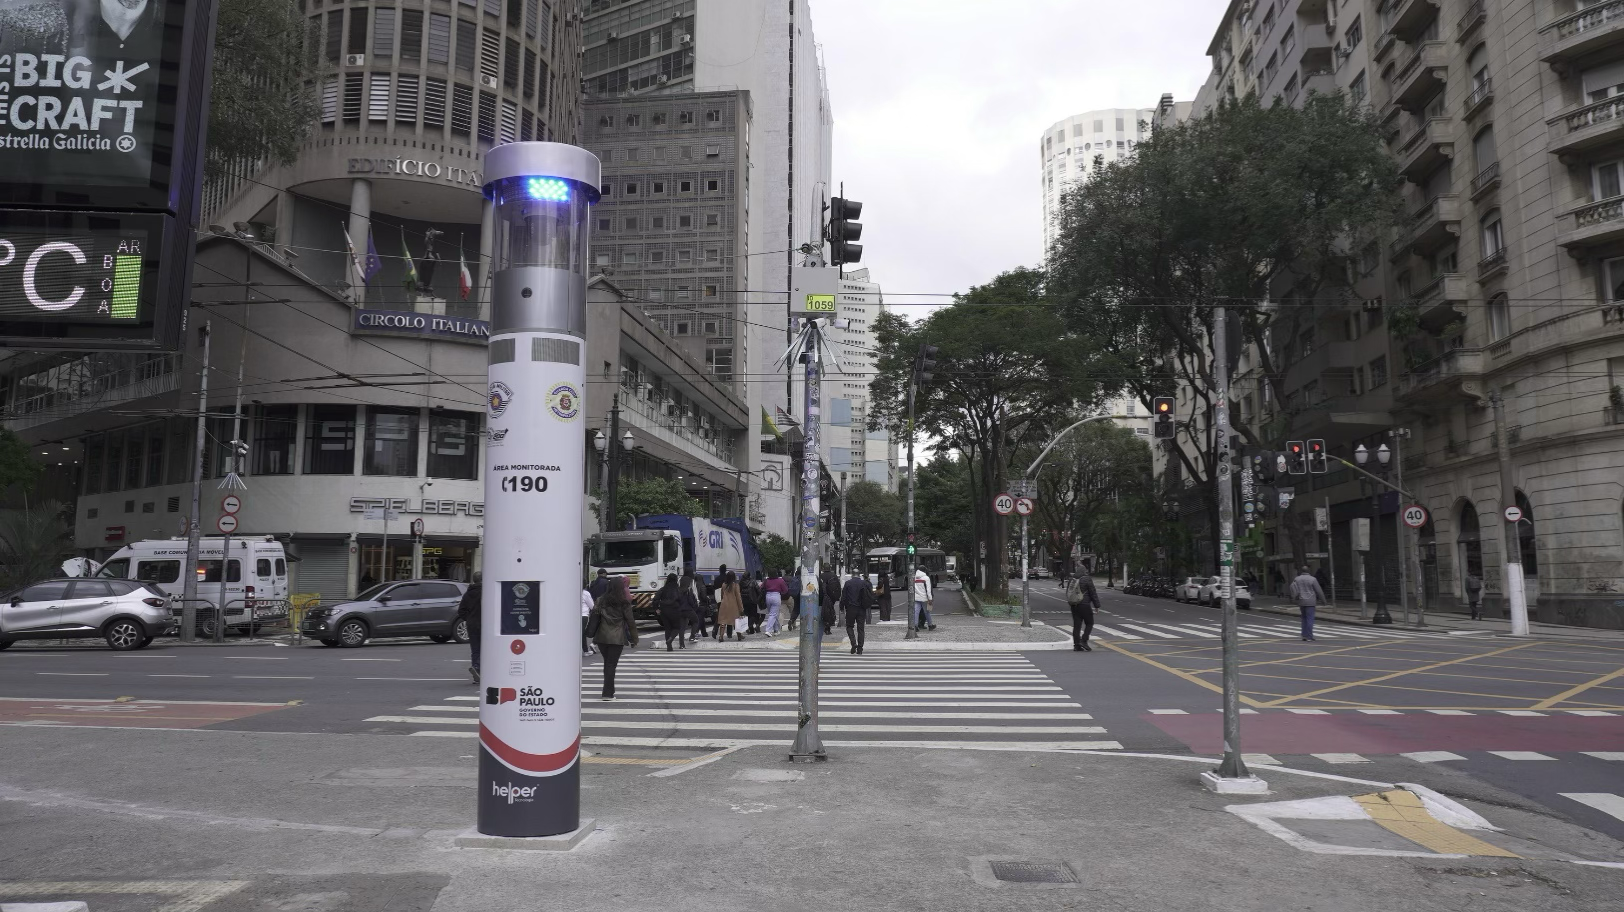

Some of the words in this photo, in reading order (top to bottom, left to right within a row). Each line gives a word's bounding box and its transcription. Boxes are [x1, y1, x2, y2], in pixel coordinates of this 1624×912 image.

[14, 53, 92, 89] BIG
[10, 95, 143, 133] CRAFT
[53, 133, 111, 151] Galicia
[347, 155, 441, 178] EDIFÍCIO
[117, 240, 141, 254] AR
[808, 300, 833, 310] 1059
[359, 313, 426, 329] CIRCOLO
[508, 475, 548, 492] 190
[997, 498, 1012, 509] 40
[1406, 510, 1422, 520] 40
[708, 530, 724, 549] GRI
[519, 685, 543, 697] SÃO
[519, 697, 555, 706] PAULO
[492, 780, 538, 805] helper
